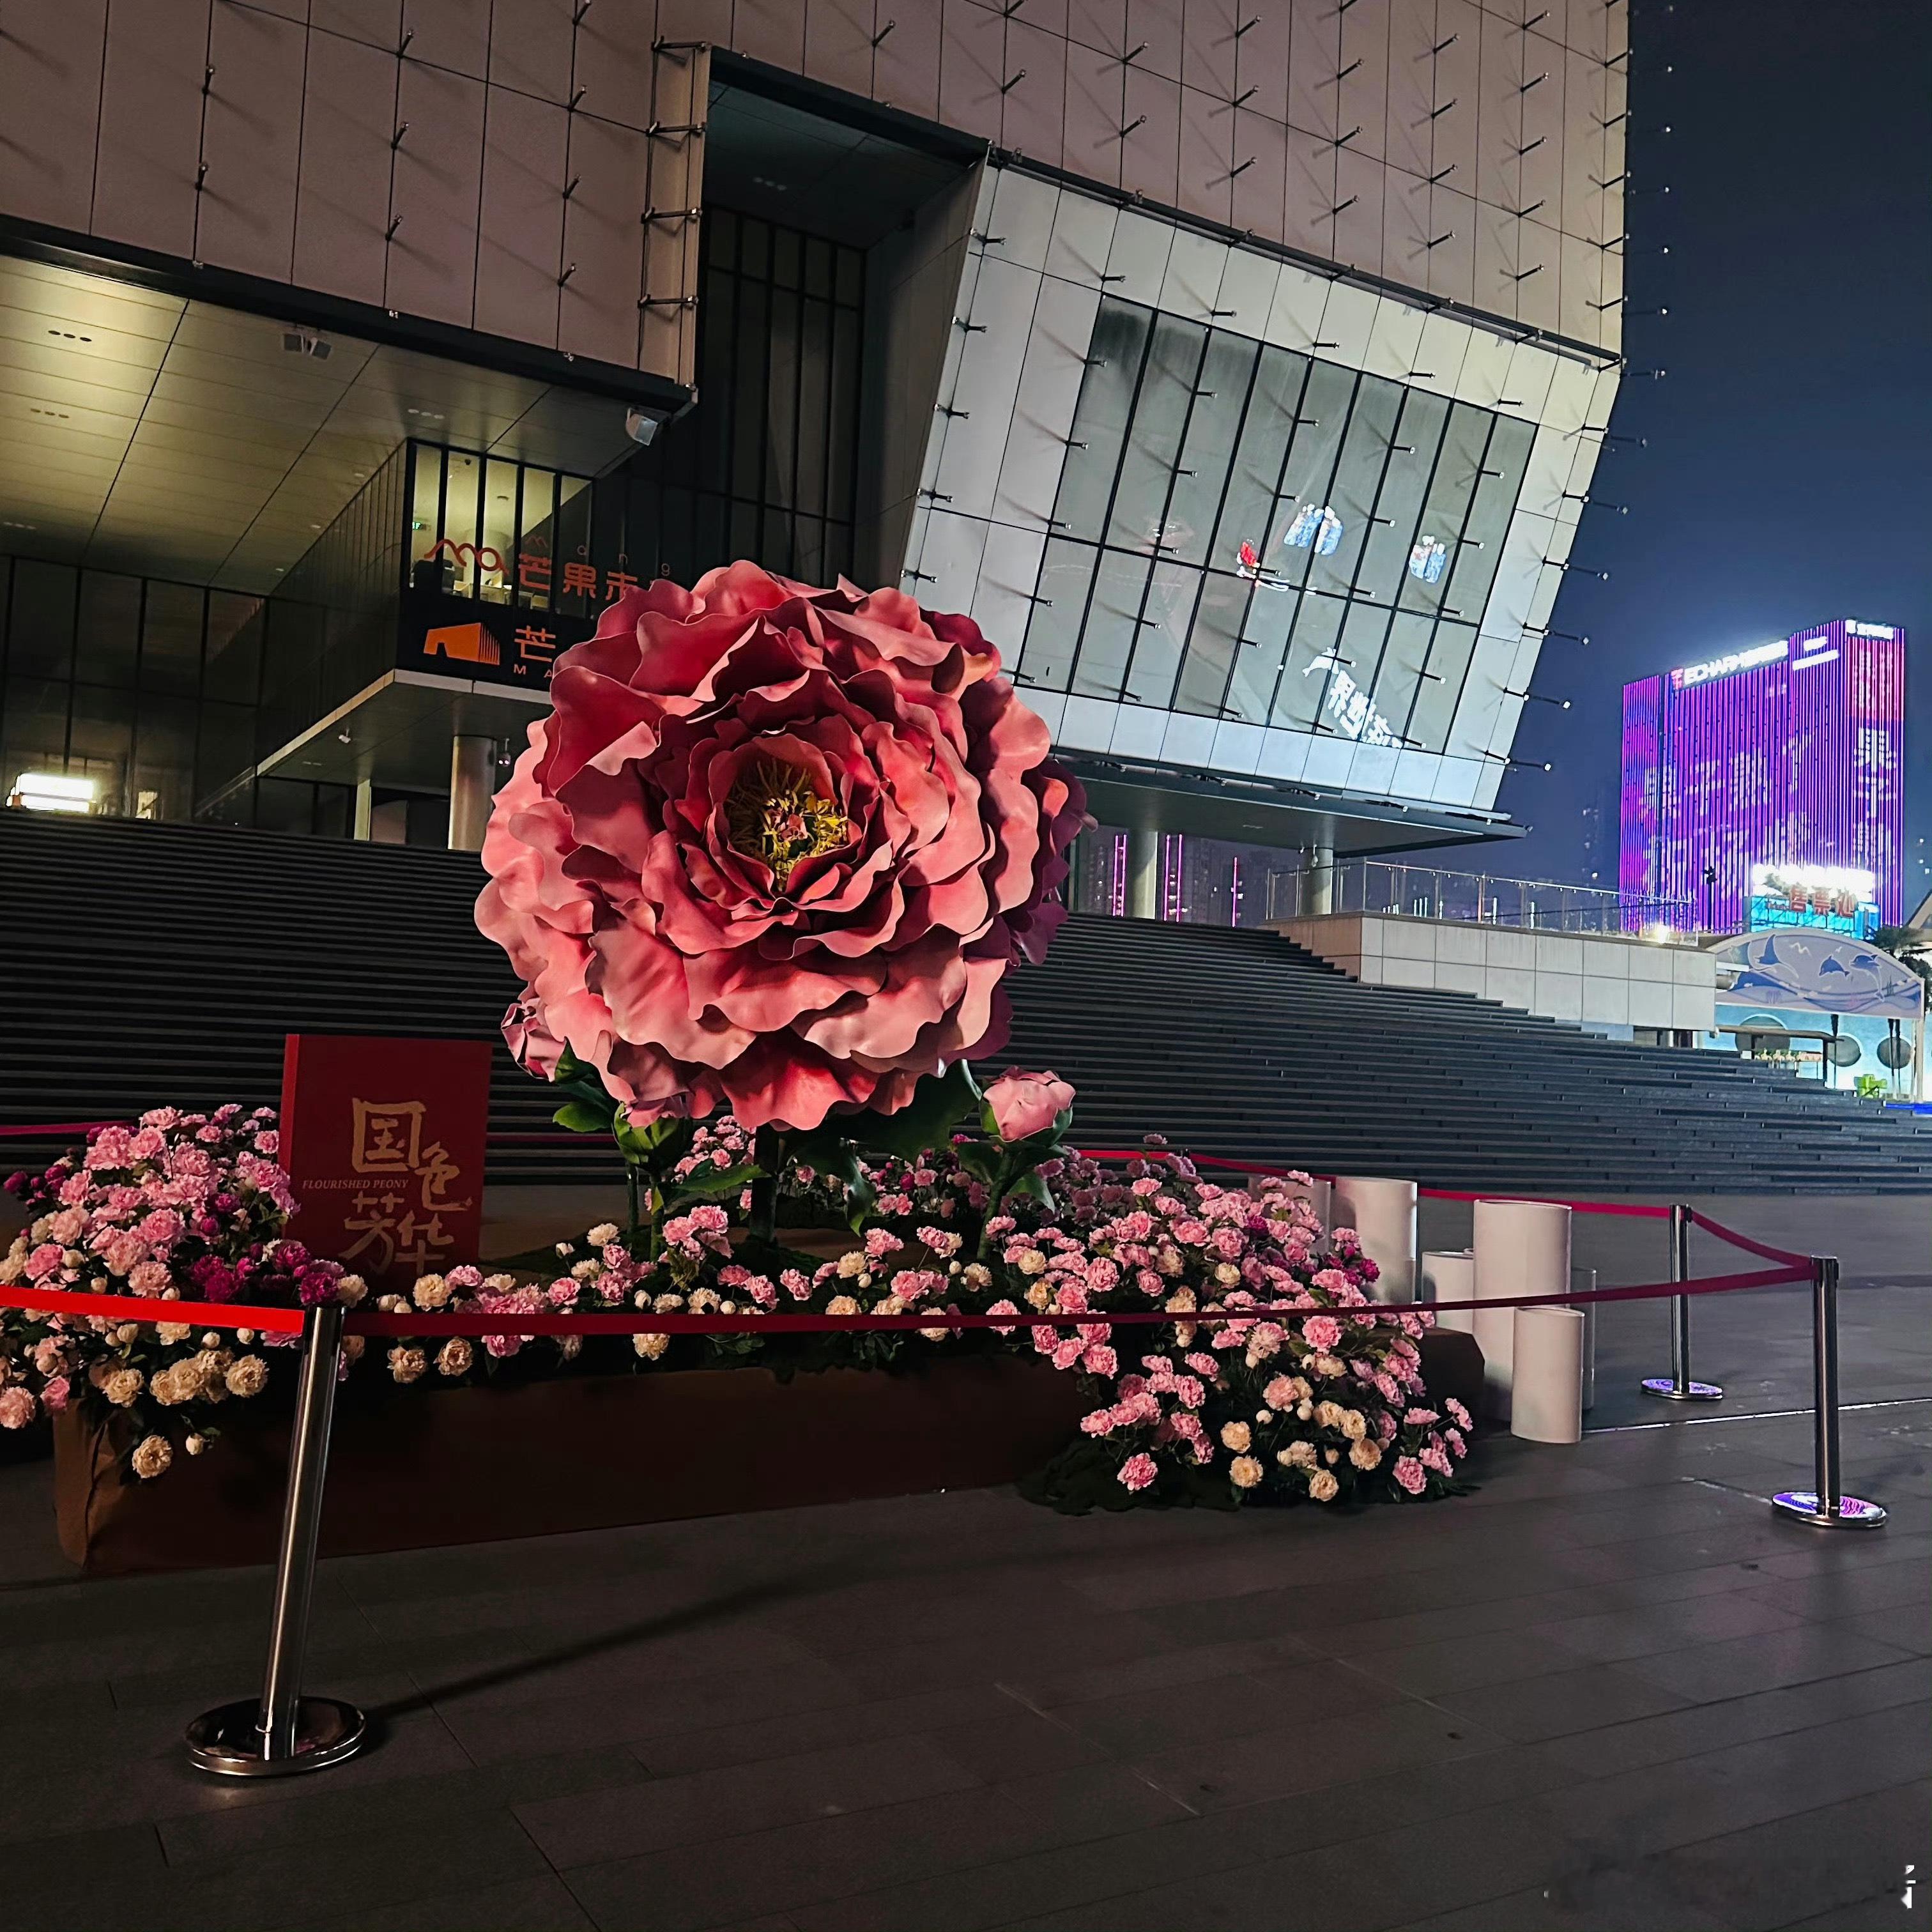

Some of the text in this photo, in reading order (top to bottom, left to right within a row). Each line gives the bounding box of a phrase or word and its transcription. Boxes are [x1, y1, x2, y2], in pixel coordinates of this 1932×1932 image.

[518, 553, 652, 601] 芒果未
[302, 1179, 409, 1190] FLOURISHED PEONY
